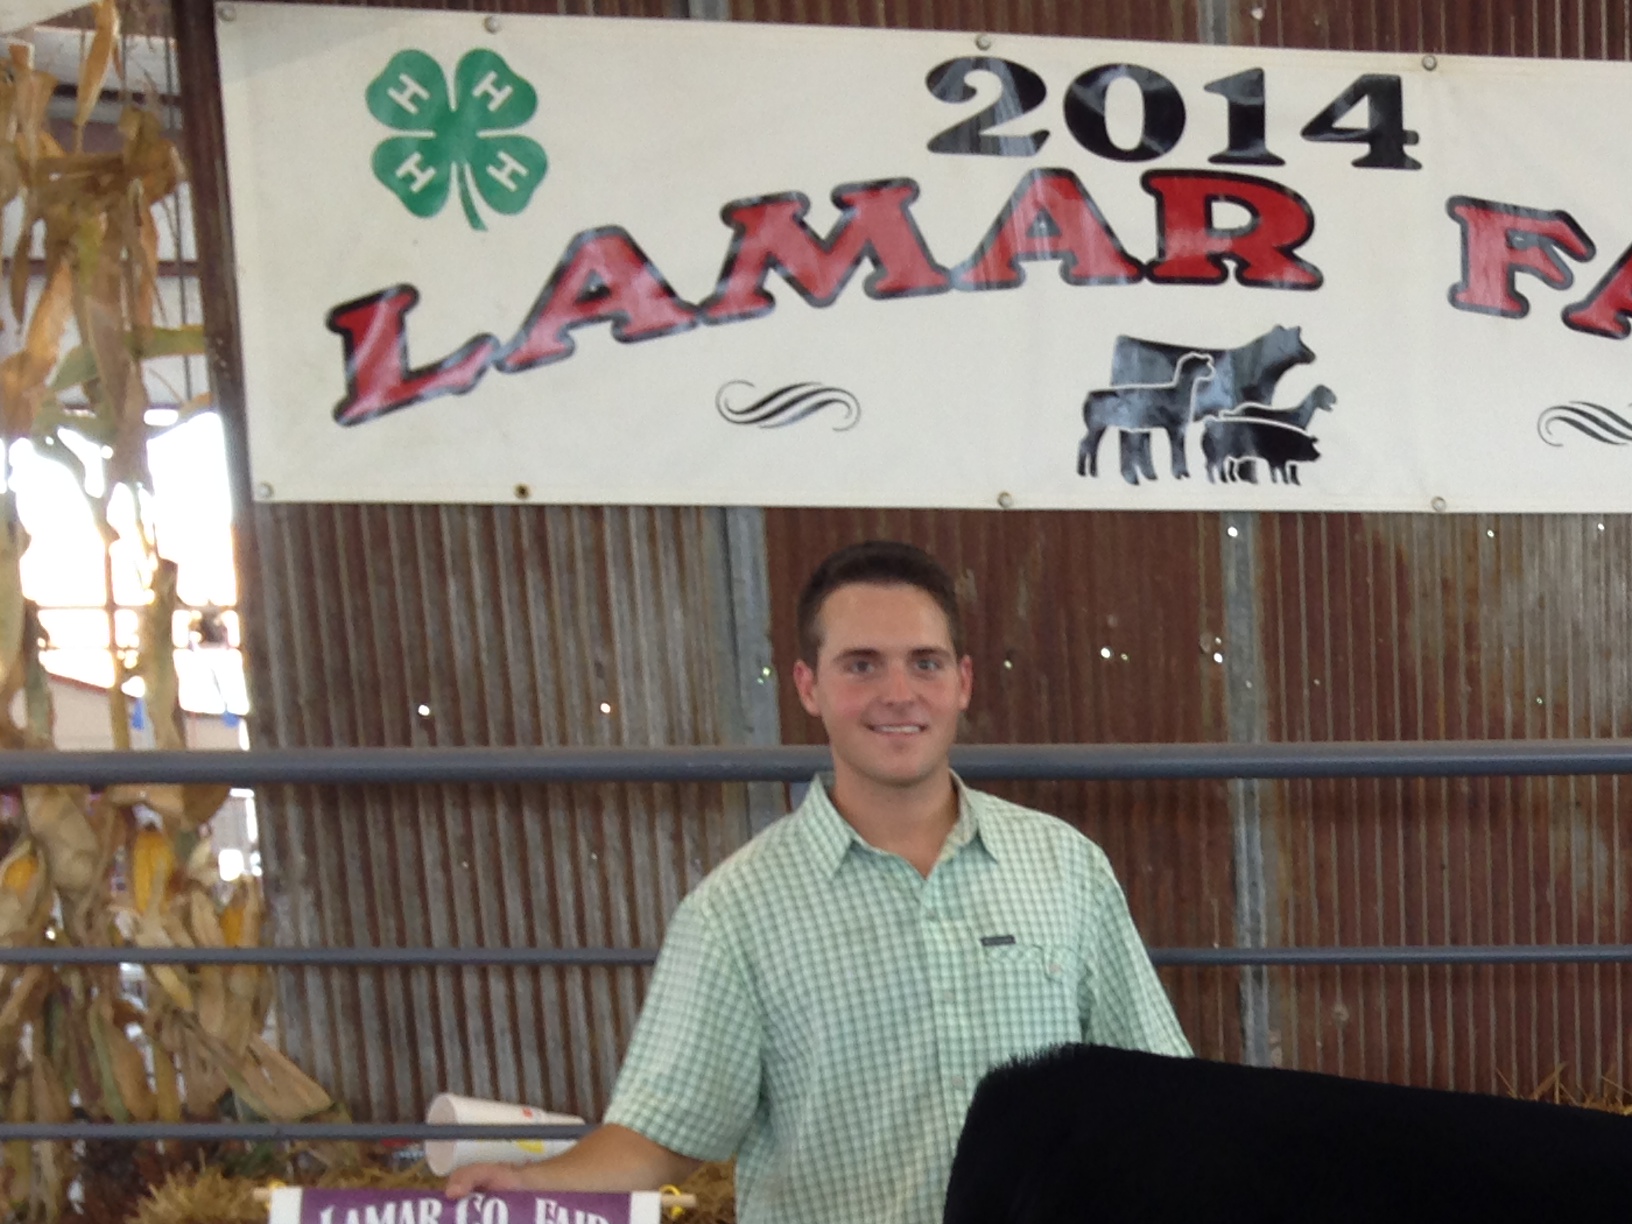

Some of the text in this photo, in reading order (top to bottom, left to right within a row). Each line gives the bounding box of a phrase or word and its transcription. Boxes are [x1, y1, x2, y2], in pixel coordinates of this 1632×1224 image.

[386, 70, 514, 115] H H
[925, 56, 1422, 170] 2014
[395, 151, 529, 194] H H
[325, 167, 1324, 427] LAMAR
